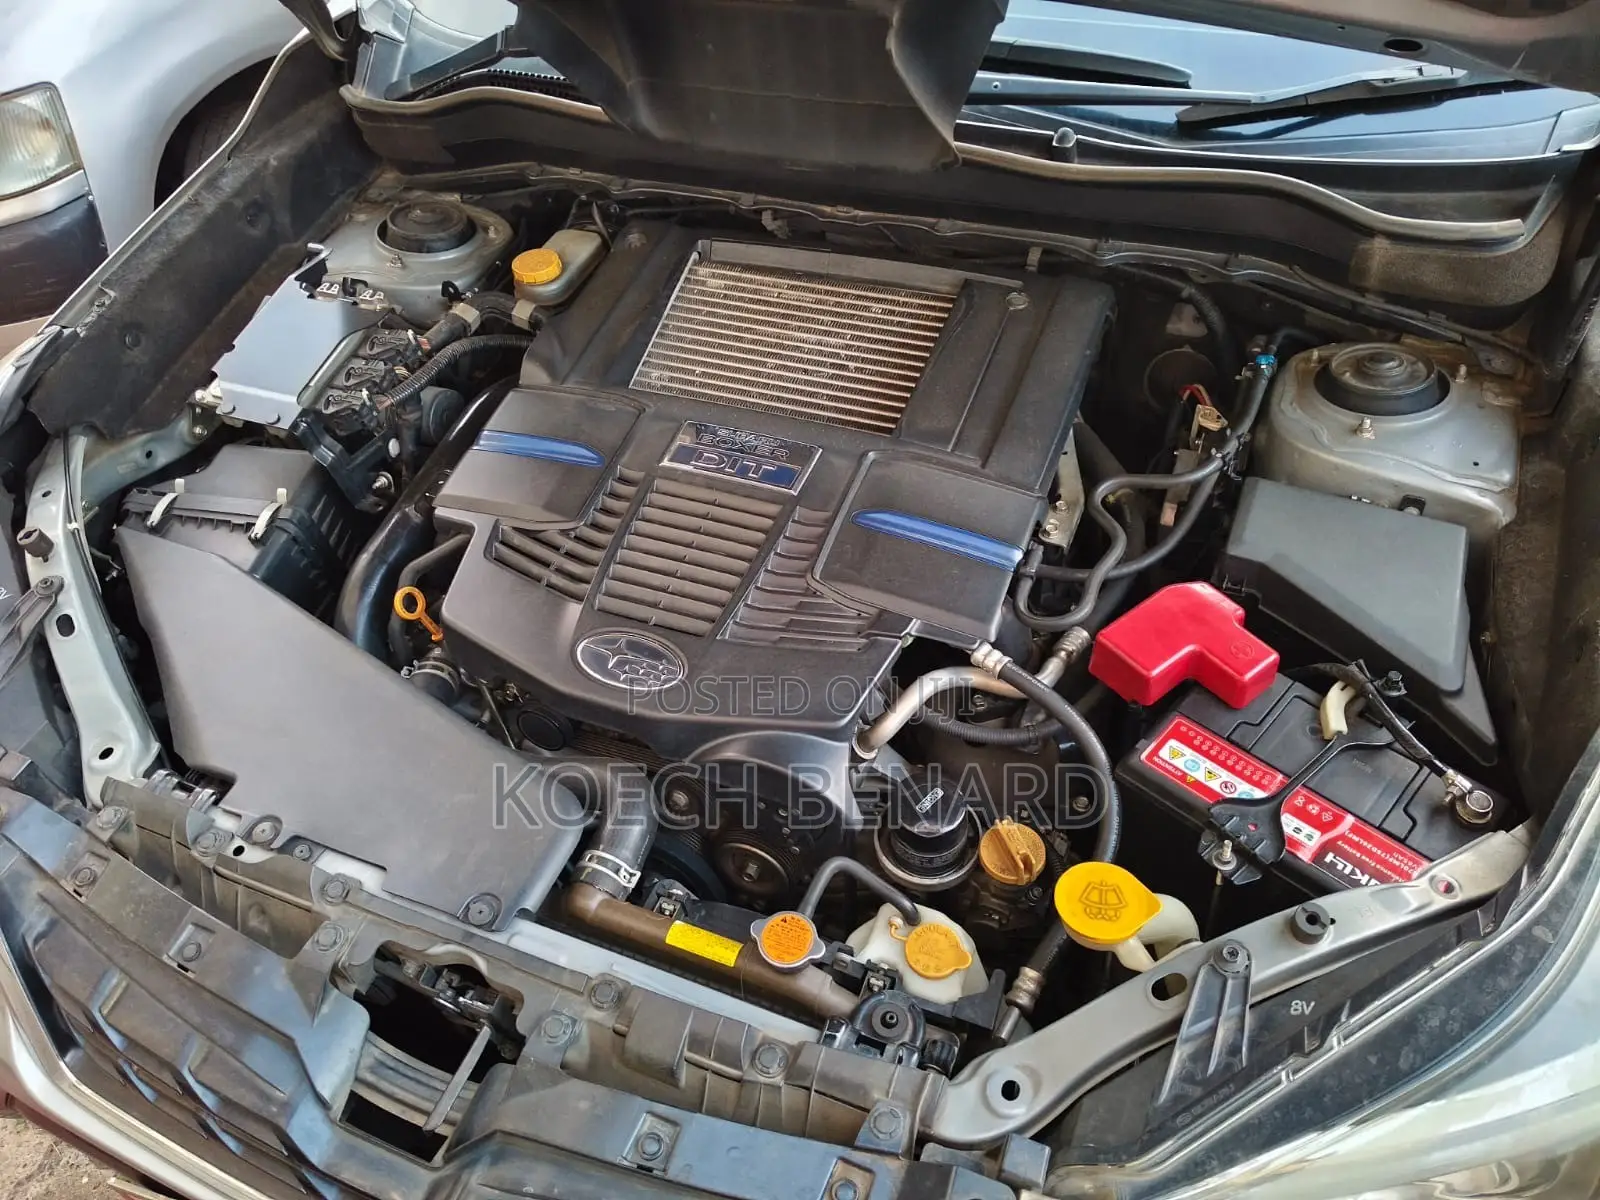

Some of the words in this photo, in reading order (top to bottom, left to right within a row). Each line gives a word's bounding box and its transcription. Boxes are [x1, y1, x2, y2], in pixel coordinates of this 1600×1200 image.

[697, 434, 790, 460] BOXER
[690, 450, 777, 478] DIT
[1290, 999, 1315, 1015] 8V
